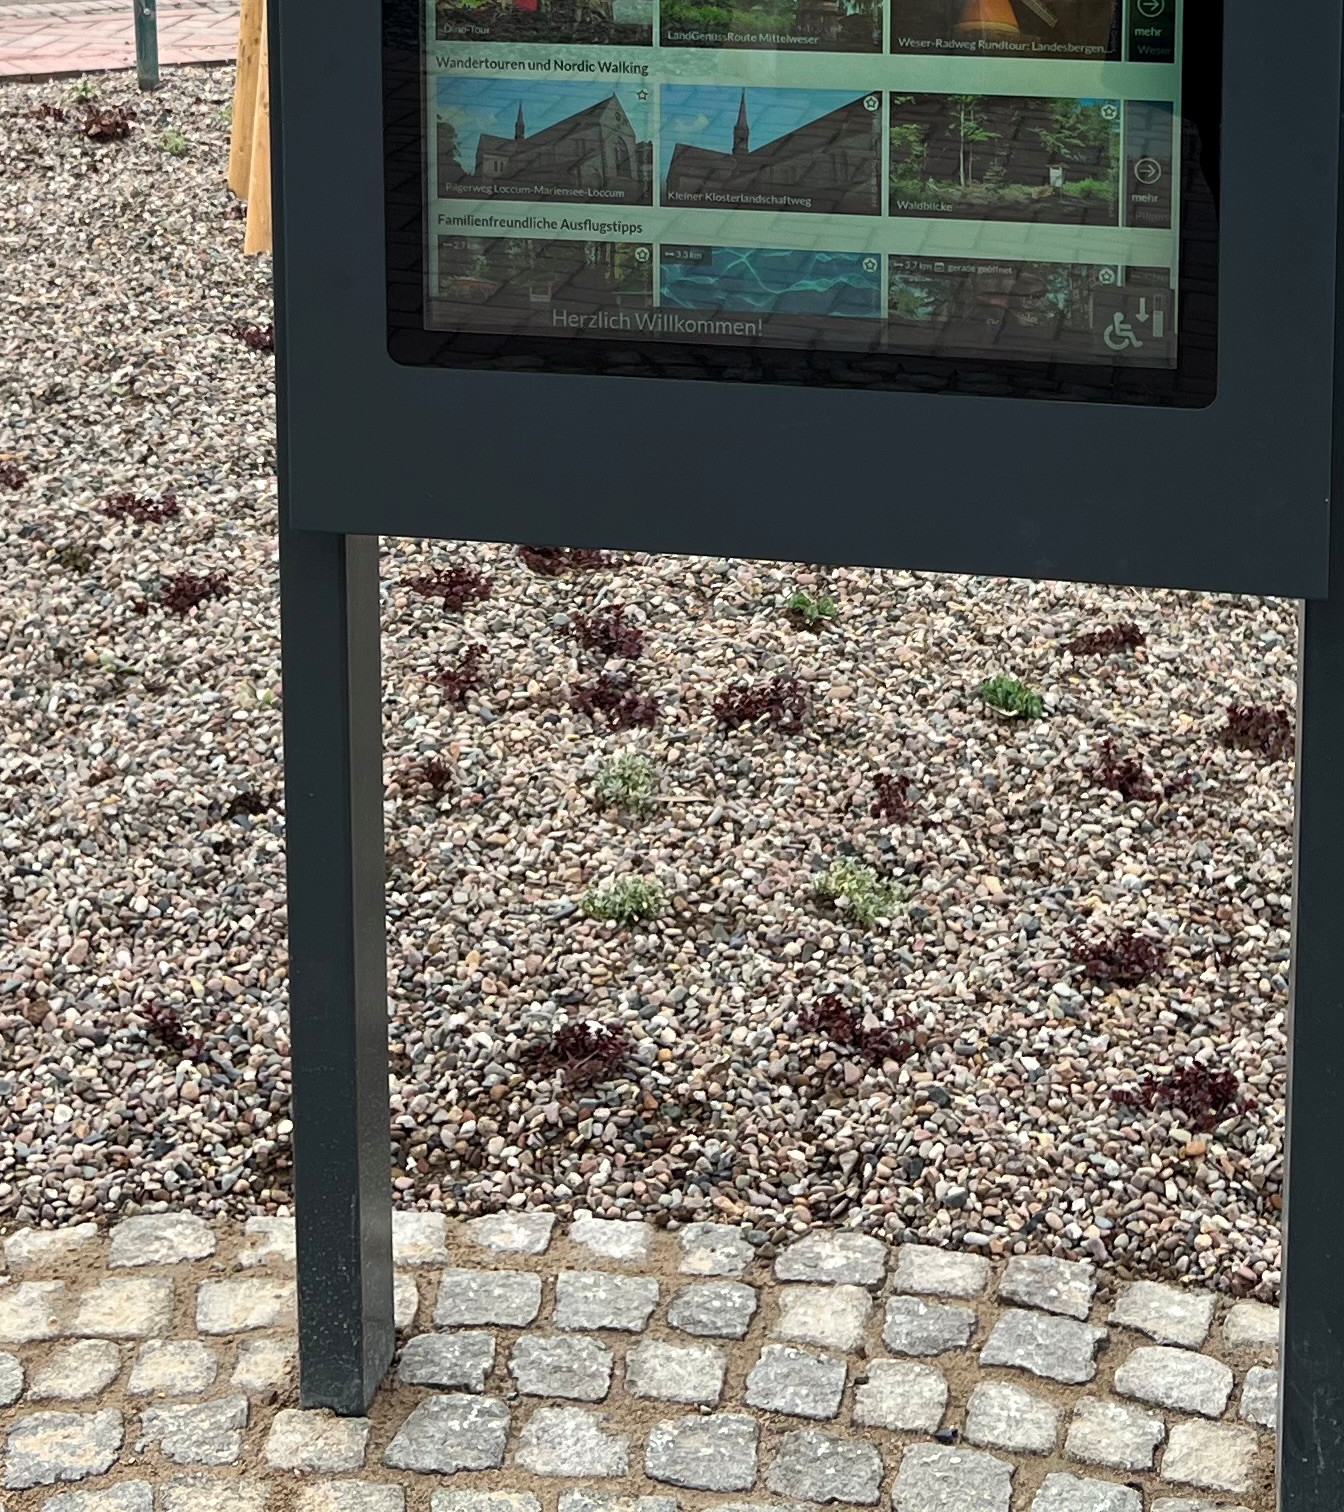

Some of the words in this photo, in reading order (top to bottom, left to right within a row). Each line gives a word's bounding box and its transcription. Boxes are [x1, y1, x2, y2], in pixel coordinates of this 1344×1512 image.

[667, 30, 757, 43] LandGenussRoute
[759, 33, 820, 45] Mittelweser
[1134, 27, 1163, 37] mehr
[898, 37, 977, 51] Weser-Radweg
[978, 39, 1030, 51] Rundtour:
[436, 56, 525, 70] Wandertouren
[528, 58, 551, 71] und
[553, 59, 595, 73] Nordic
[597, 61, 649, 77] Walking
[493, 184, 626, 199] Loccum-Mariensee-Loccum
[667, 190, 704, 201] Kleiner
[1131, 193, 1160, 203] mehr
[896, 200, 953, 213] Waldblicke
[438, 214, 558, 230] Familienfreundliche
[560, 218, 643, 235] Ausflugstipps
[552, 308, 631, 330] Herzlich
[634, 313, 764, 337] Willkommen!
